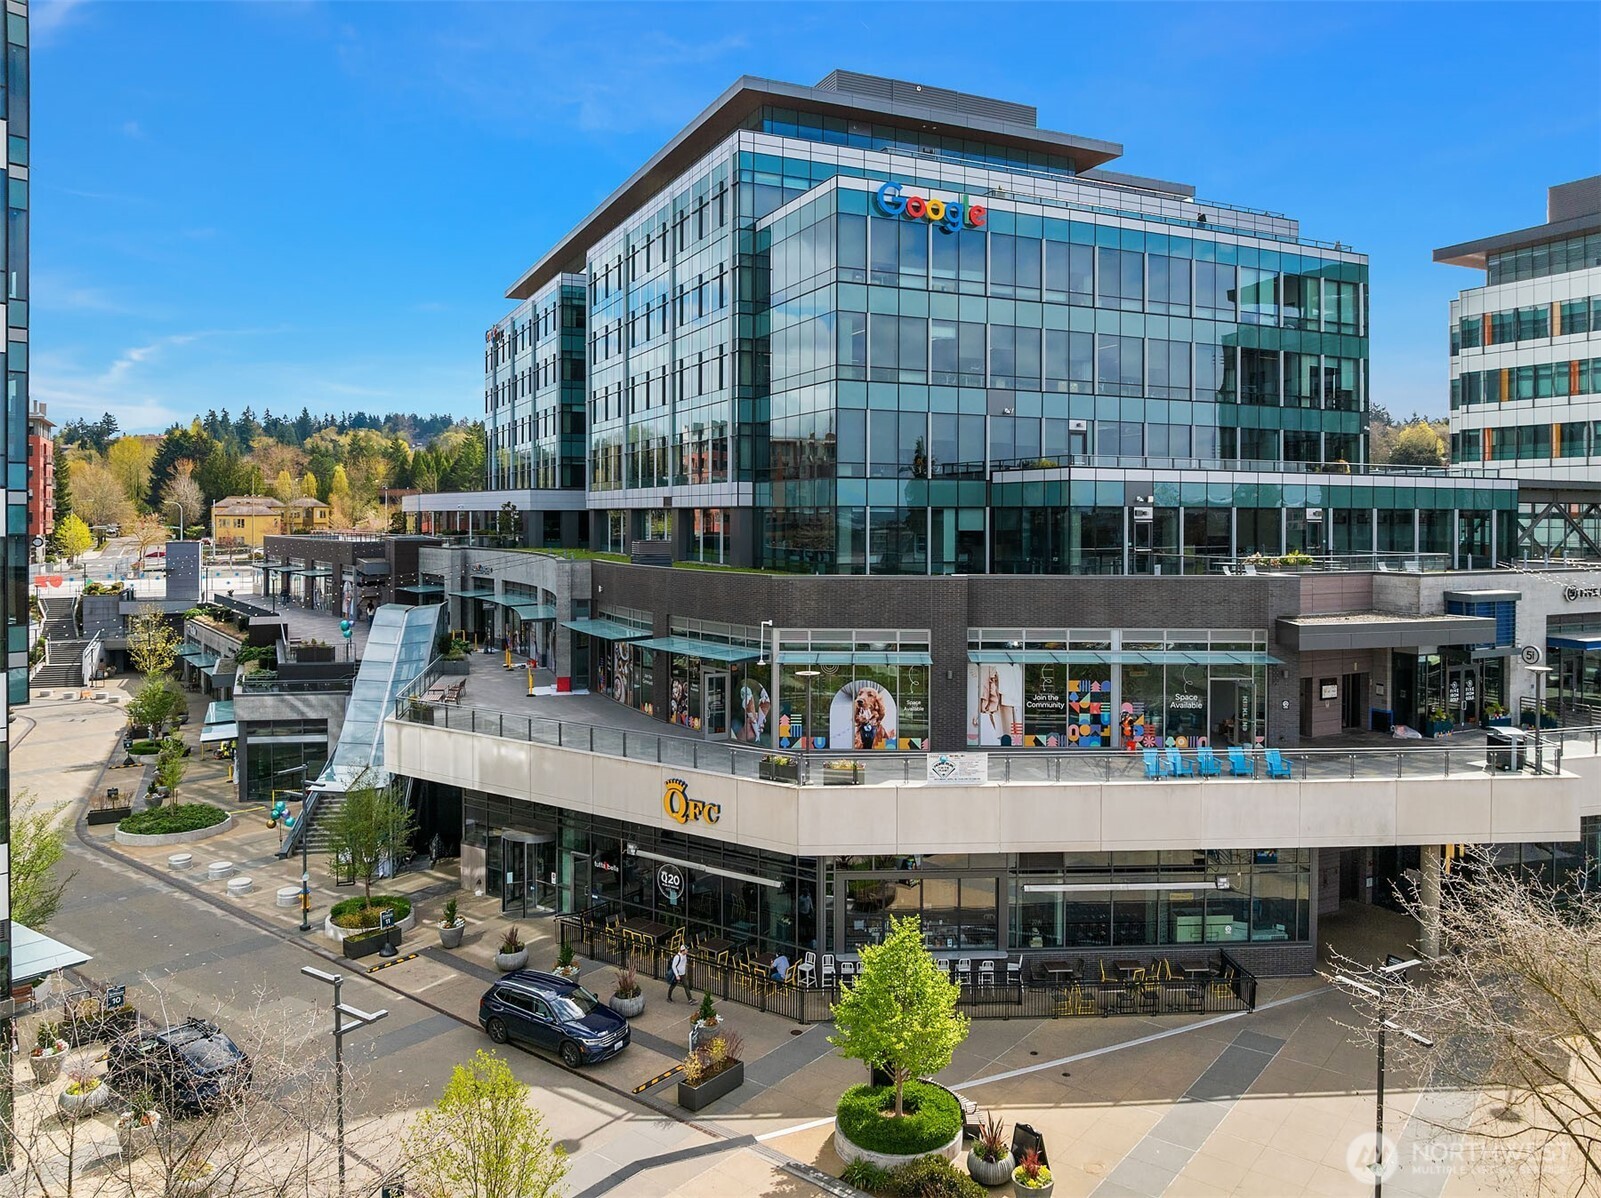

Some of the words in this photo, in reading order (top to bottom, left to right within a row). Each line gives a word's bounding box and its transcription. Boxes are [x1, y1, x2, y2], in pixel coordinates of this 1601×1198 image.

[876, 181, 986, 232] Google
[1175, 694, 1198, 702] Space
[1026, 701, 1065, 710] Community
[664, 786, 721, 824] QFC
[661, 871, 680, 886] Q20
[112, 996, 121, 1004] 10
